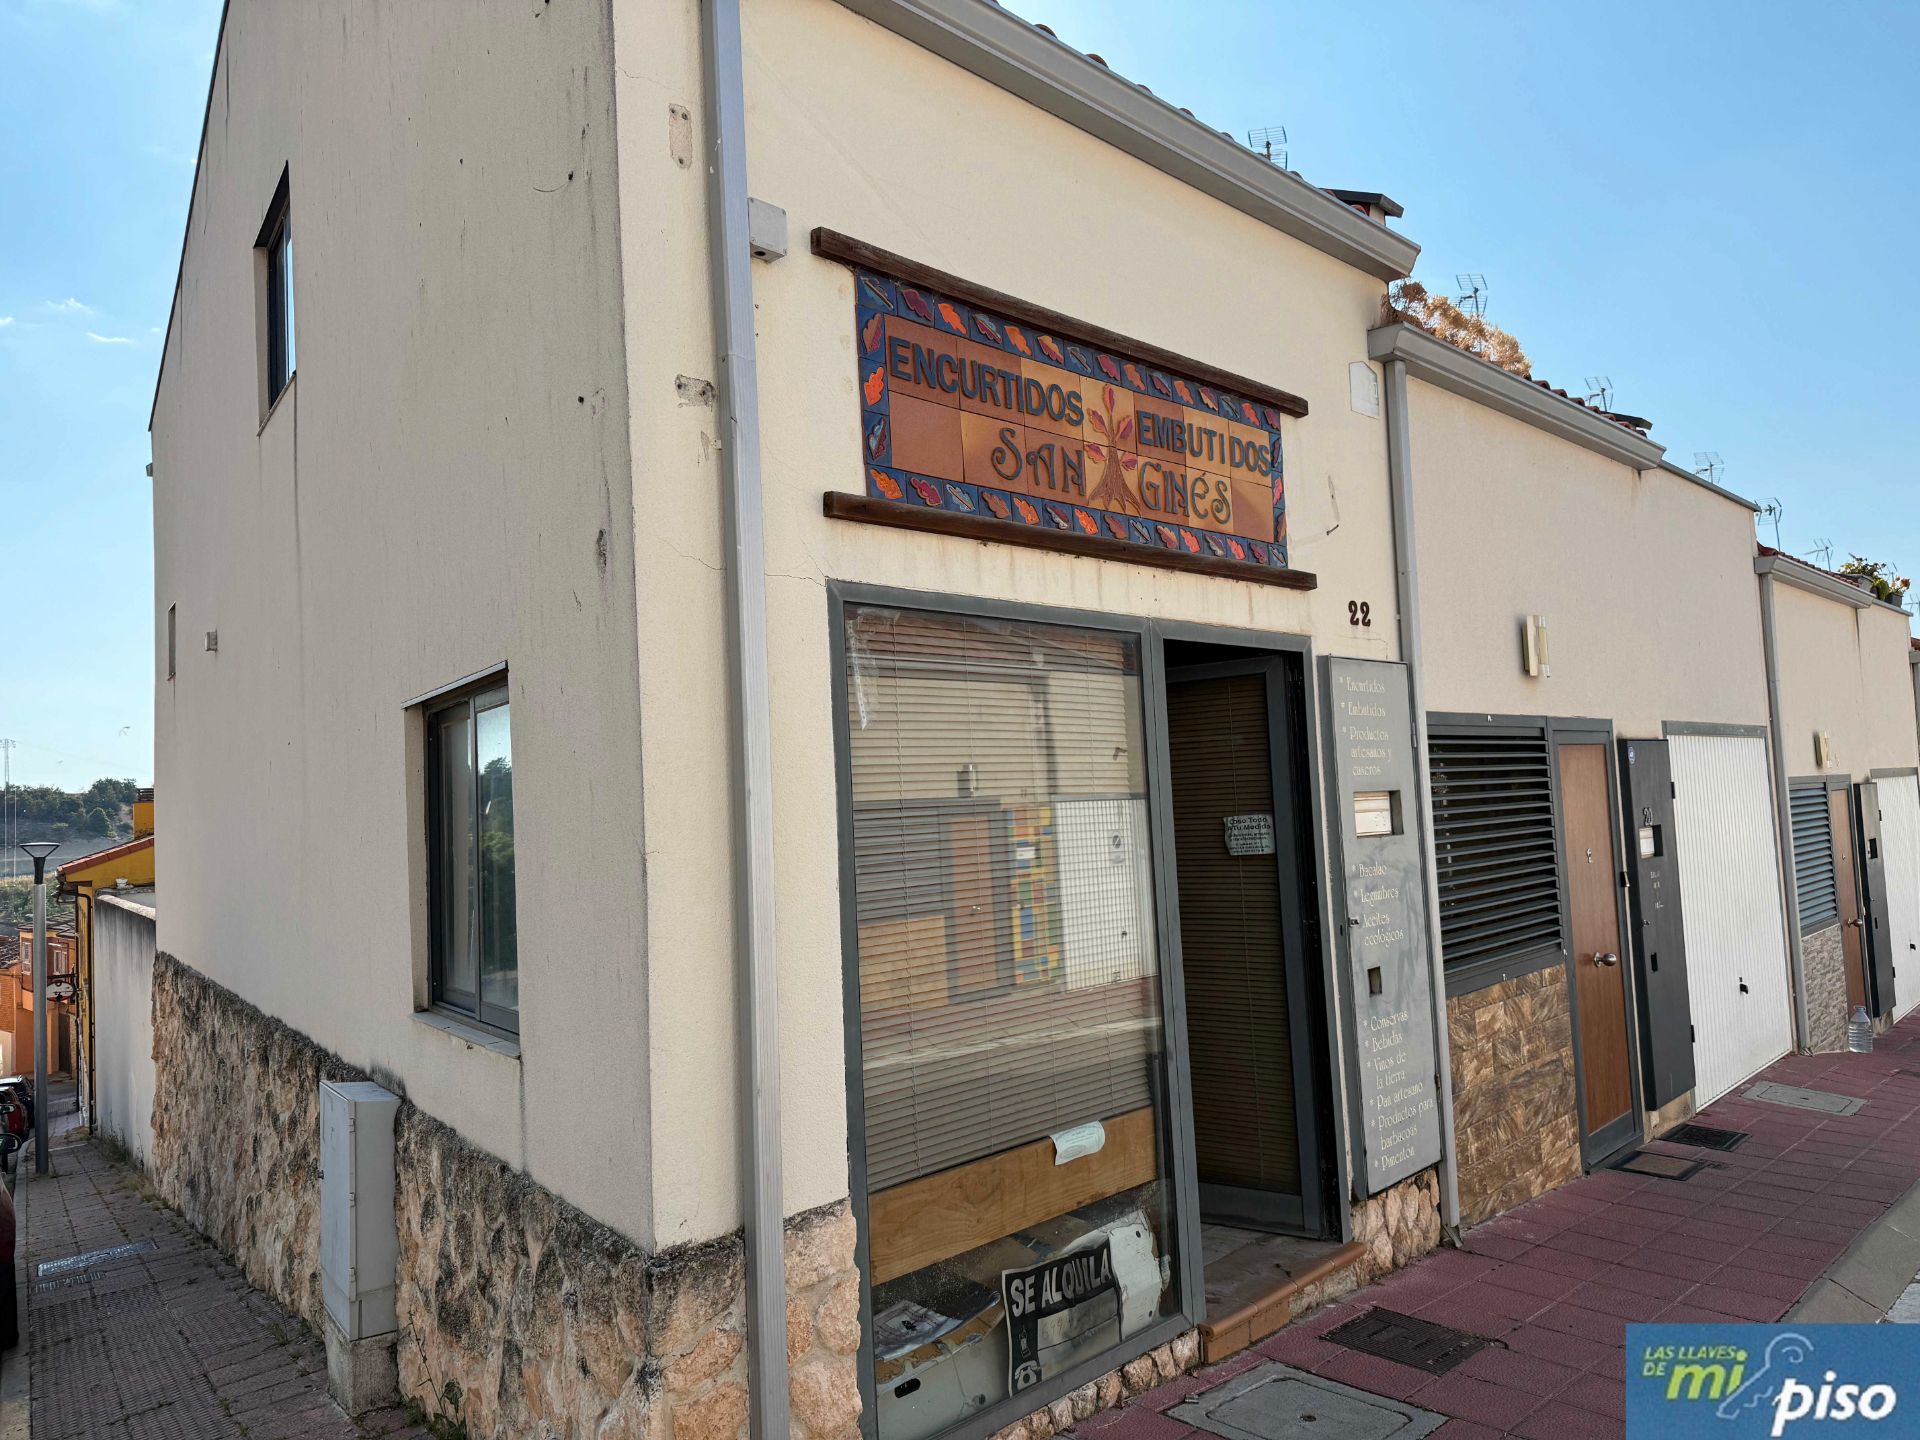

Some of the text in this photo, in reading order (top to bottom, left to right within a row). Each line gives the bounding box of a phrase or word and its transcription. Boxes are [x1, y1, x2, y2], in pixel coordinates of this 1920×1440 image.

[889, 335, 1273, 477] ENCURTIDOS EMBUTIDOS
[990, 427, 1086, 497] SAN
[1348, 600, 1371, 627] 22
[1346, 676, 1386, 693] Encurtidos
[1348, 701, 1386, 717] Embutidos
[1349, 726, 1389, 741] Productos
[1351, 746, 1392, 763] artesanos y
[1352, 766, 1382, 776] caseros
[1359, 861, 1388, 878] Bacalao
[1360, 885, 1399, 907] Legumbres
[1362, 912, 1390, 928] Aceites
[1370, 1010, 1409, 1031] Conservas
[1372, 1031, 1403, 1052] Bebidas
[1374, 1049, 1407, 1072] Vinos de
[1376, 1070, 1406, 1090] la tierra
[1377, 1082, 1424, 1110] Pan artesano
[1378, 1098, 1434, 1131] Productos para
[1380, 1124, 1418, 1151] barbacoas
[1010, 1248, 1113, 1318] SE ALQUILA
